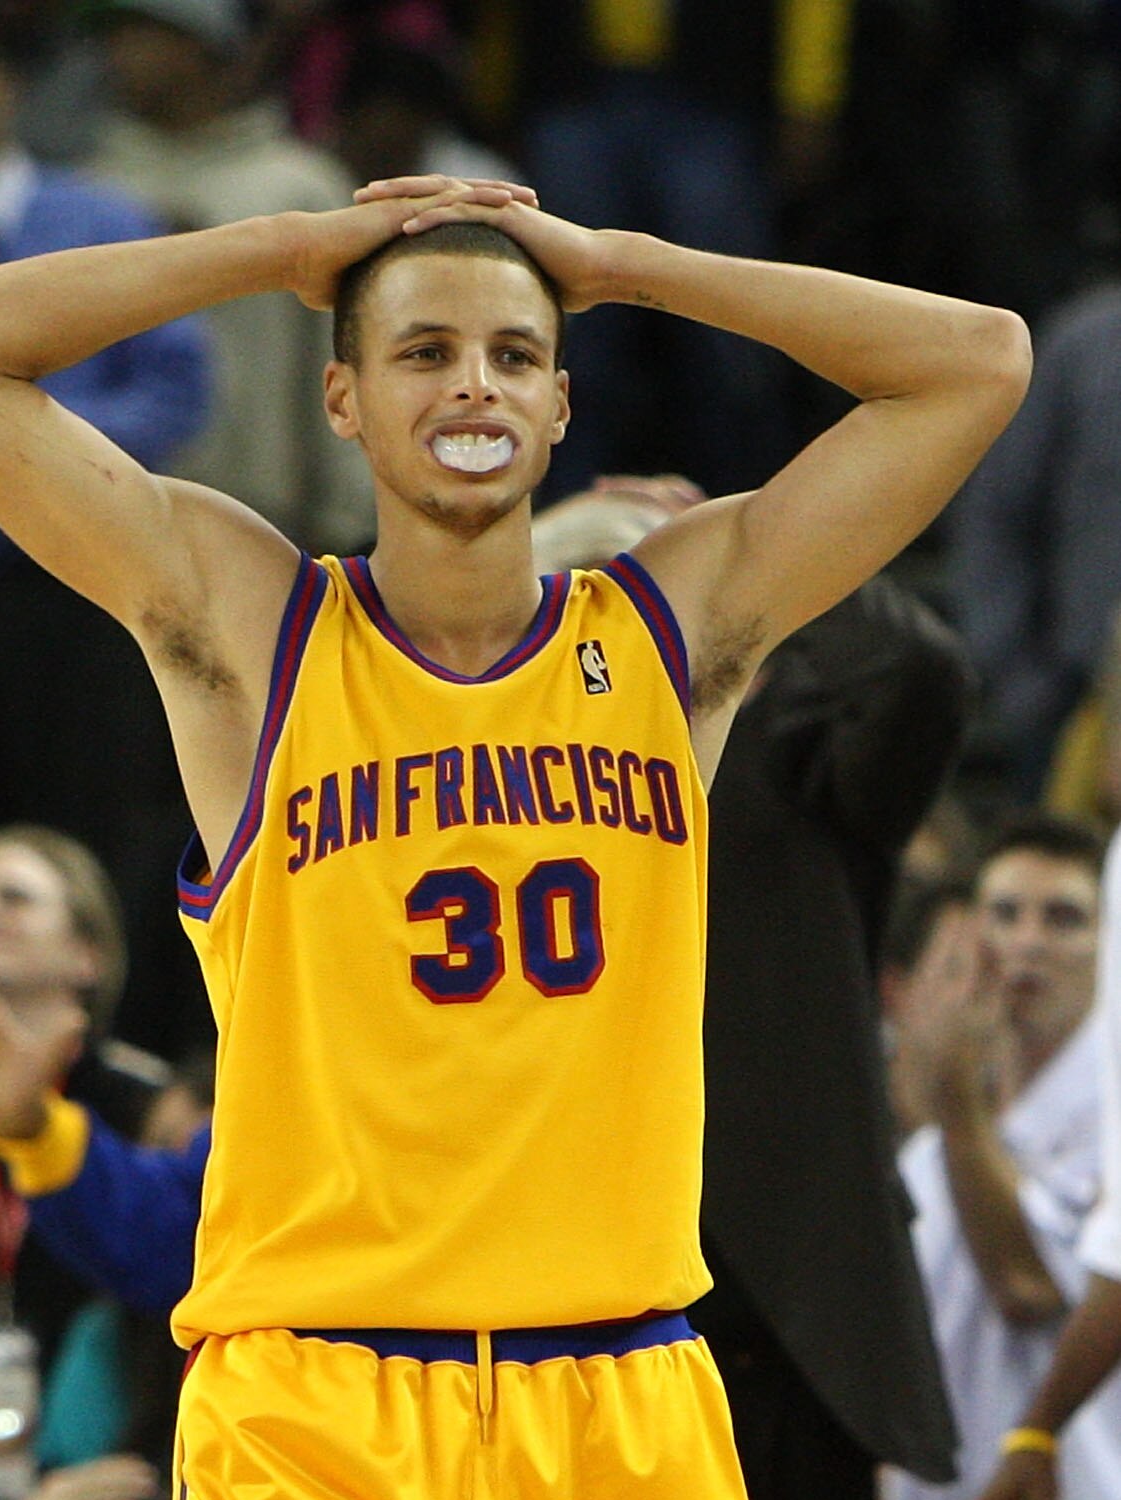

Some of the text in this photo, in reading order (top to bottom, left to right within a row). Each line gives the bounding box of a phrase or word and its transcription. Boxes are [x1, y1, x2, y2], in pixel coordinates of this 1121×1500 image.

[287, 743, 689, 875] SAN FRANCISCO
[405, 856, 607, 1005] 30
